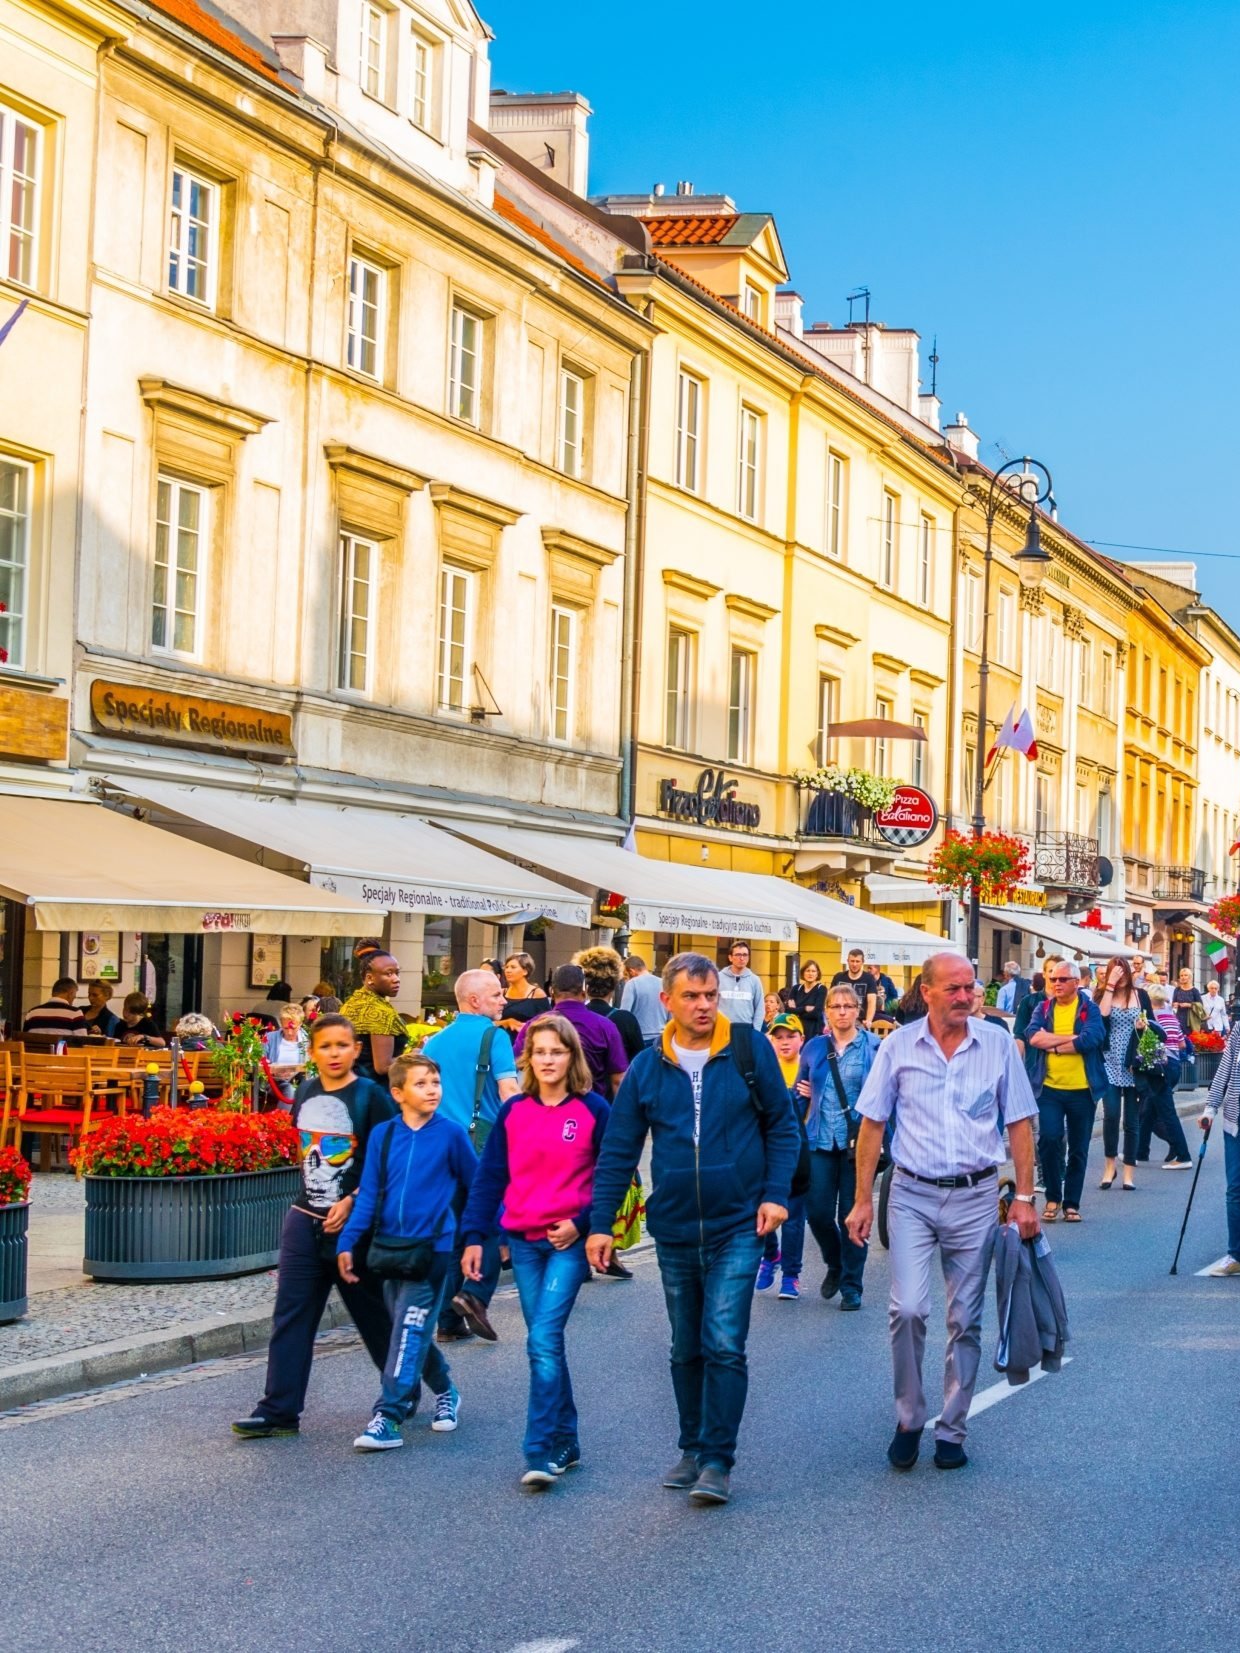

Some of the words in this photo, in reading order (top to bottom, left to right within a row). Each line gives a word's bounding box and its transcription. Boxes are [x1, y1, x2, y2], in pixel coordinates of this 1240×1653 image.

[104, 691, 181, 732] Specjały
[188, 707, 284, 745] Regionalne
[362, 884, 396, 908] Specjały
[399, 888, 442, 908] Regionalne
[450, 895, 486, 911] traditional
[658, 912, 680, 929] Specjały
[681, 914, 708, 930] Regionalne
[712, 917, 737, 933] tradycyjna
[738, 920, 753, 935] polska
[754, 921, 772, 934] kuchnia
[562, 1118, 577, 1142] C
